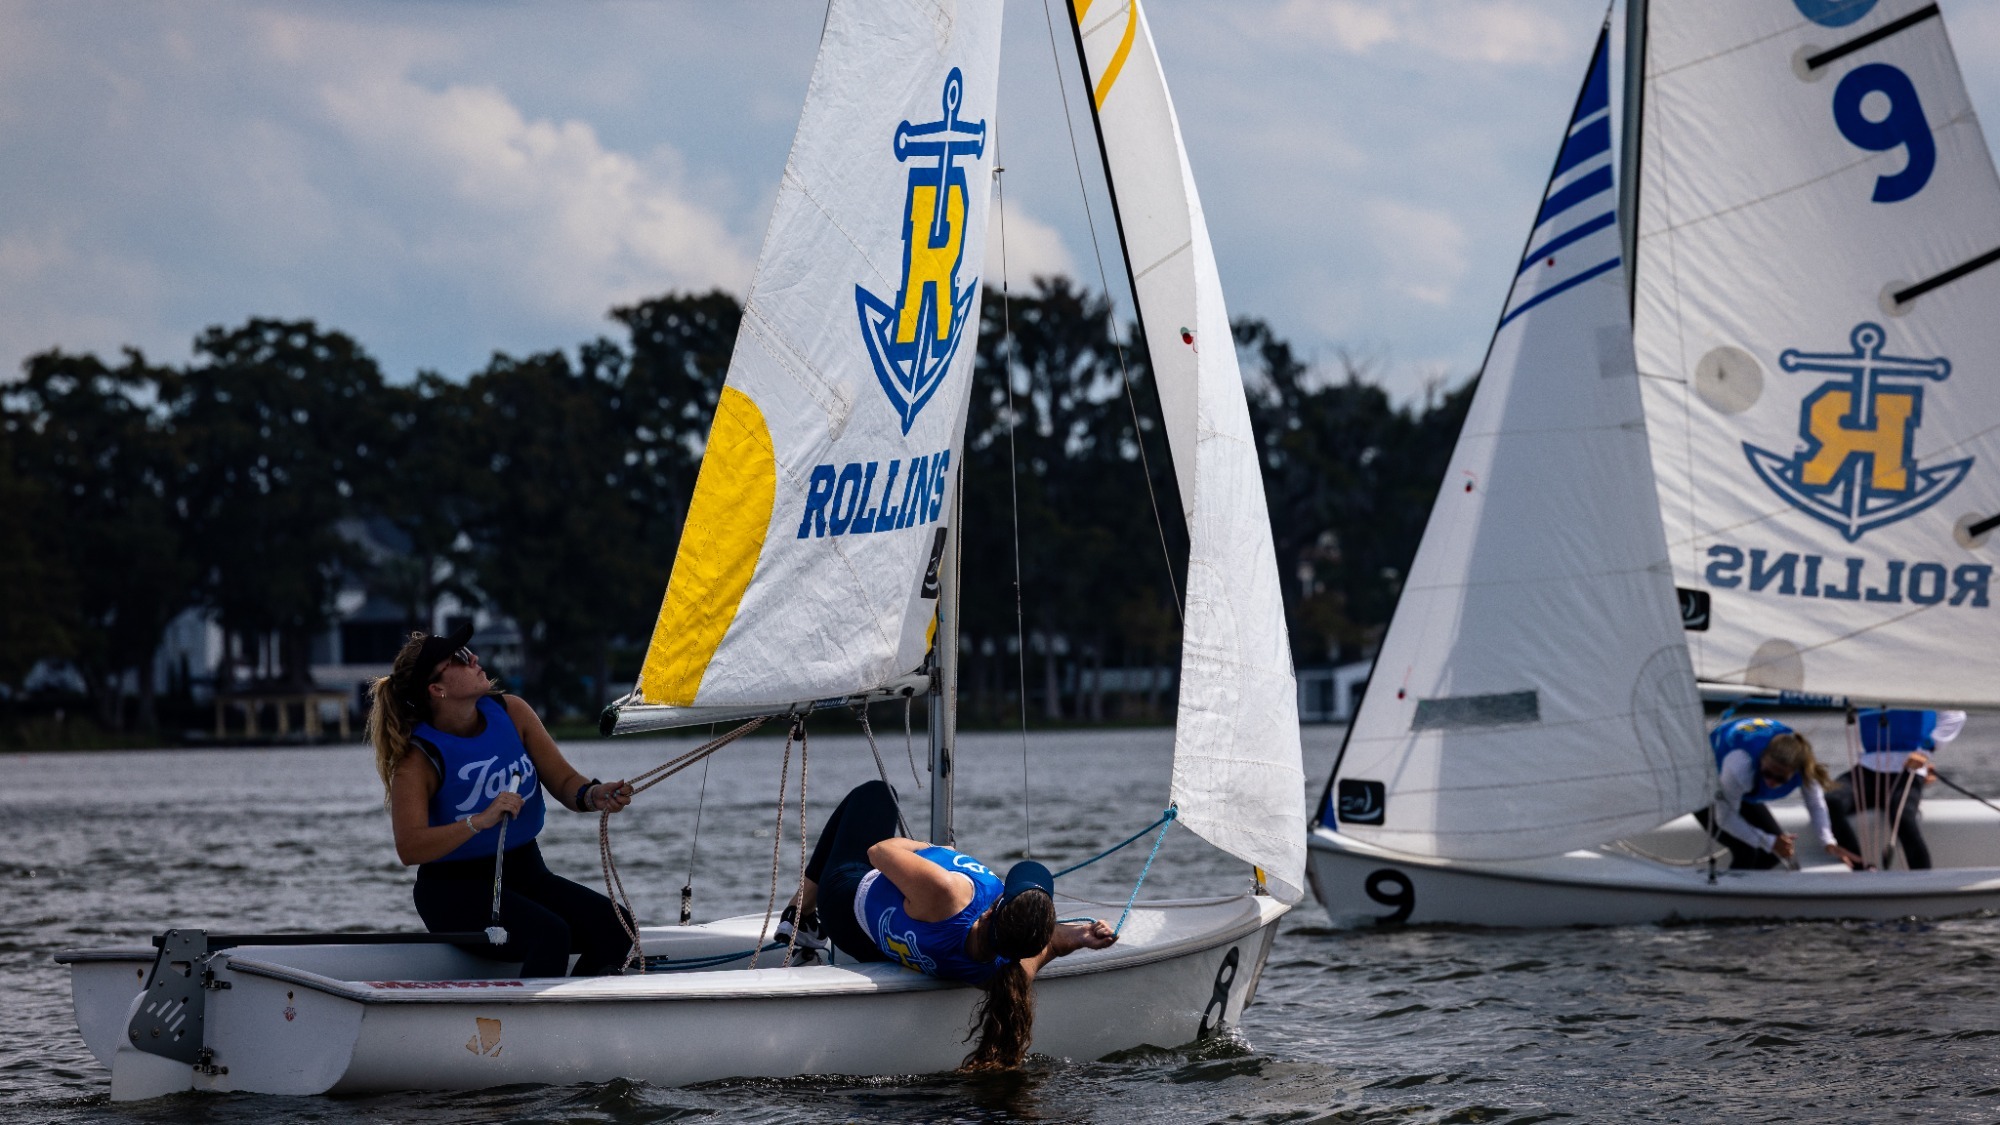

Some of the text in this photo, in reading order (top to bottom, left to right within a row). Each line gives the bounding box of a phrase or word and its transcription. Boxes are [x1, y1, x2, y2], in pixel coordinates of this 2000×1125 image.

[1833, 63, 1936, 203] 9
[896, 167, 970, 356] R
[797, 450, 951, 539] ROLLINS
[1365, 868, 1415, 926] 9
[1197, 946, 1239, 1040] 8
